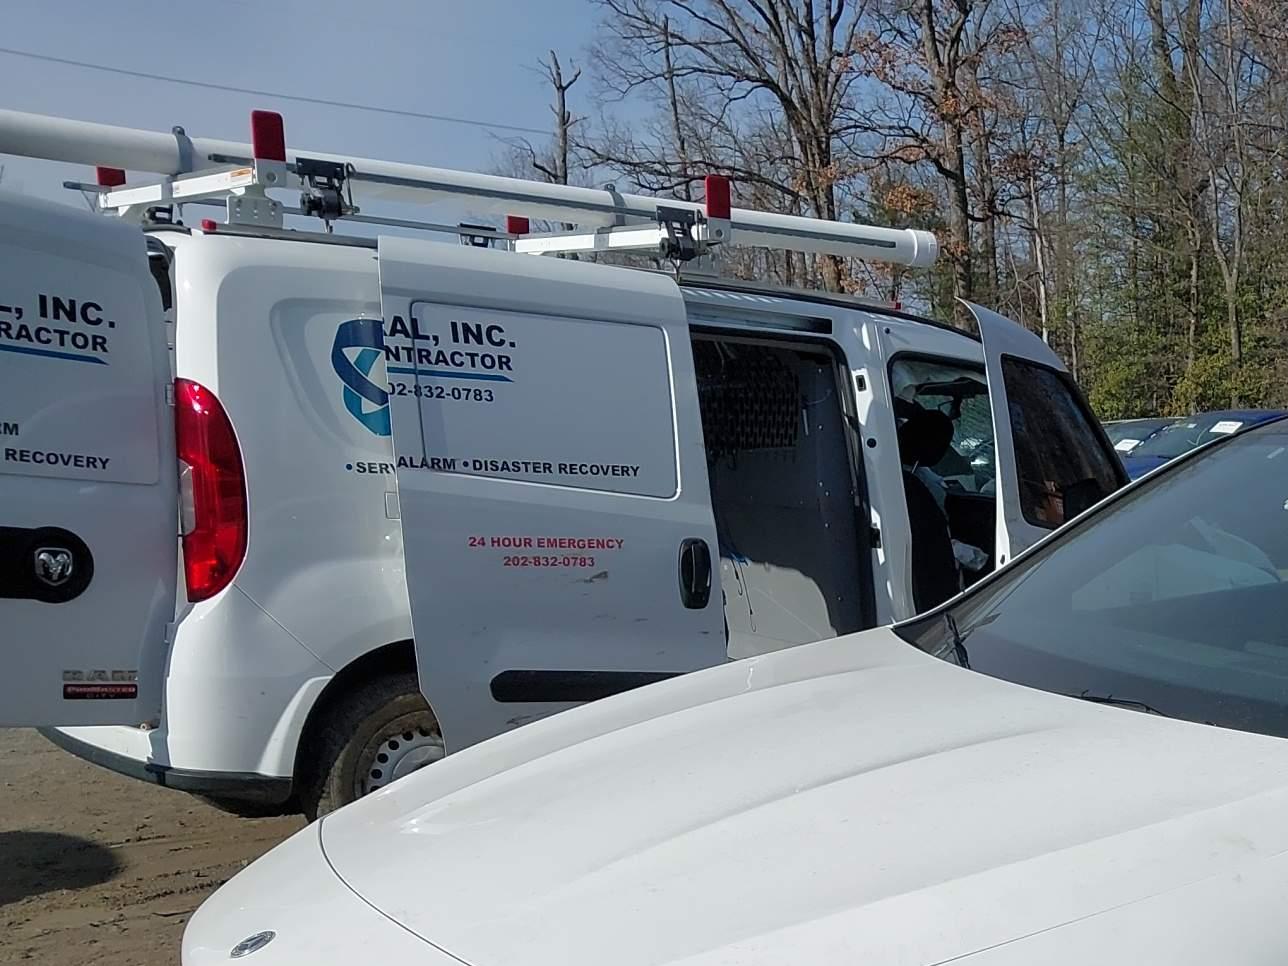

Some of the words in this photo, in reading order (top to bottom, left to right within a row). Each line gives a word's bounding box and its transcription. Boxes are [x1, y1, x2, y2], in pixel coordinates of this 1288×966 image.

[38, 294, 115, 328] INC.
[384, 316, 439, 346] AL,
[451, 321, 516, 348] INC.
[385, 345, 512, 371] NTRACTOR
[5, 448, 110, 470] RECOVERY
[397, 456, 456, 470] ALARM
[472, 459, 553, 474] DISASTER
[558, 463, 640, 477] RECOVERY
[468, 536, 486, 548] 24
[491, 537, 533, 548] HOUR
[537, 538, 624, 549] EMERGENCY
[503, 556, 595, 567] 202-832-0783
